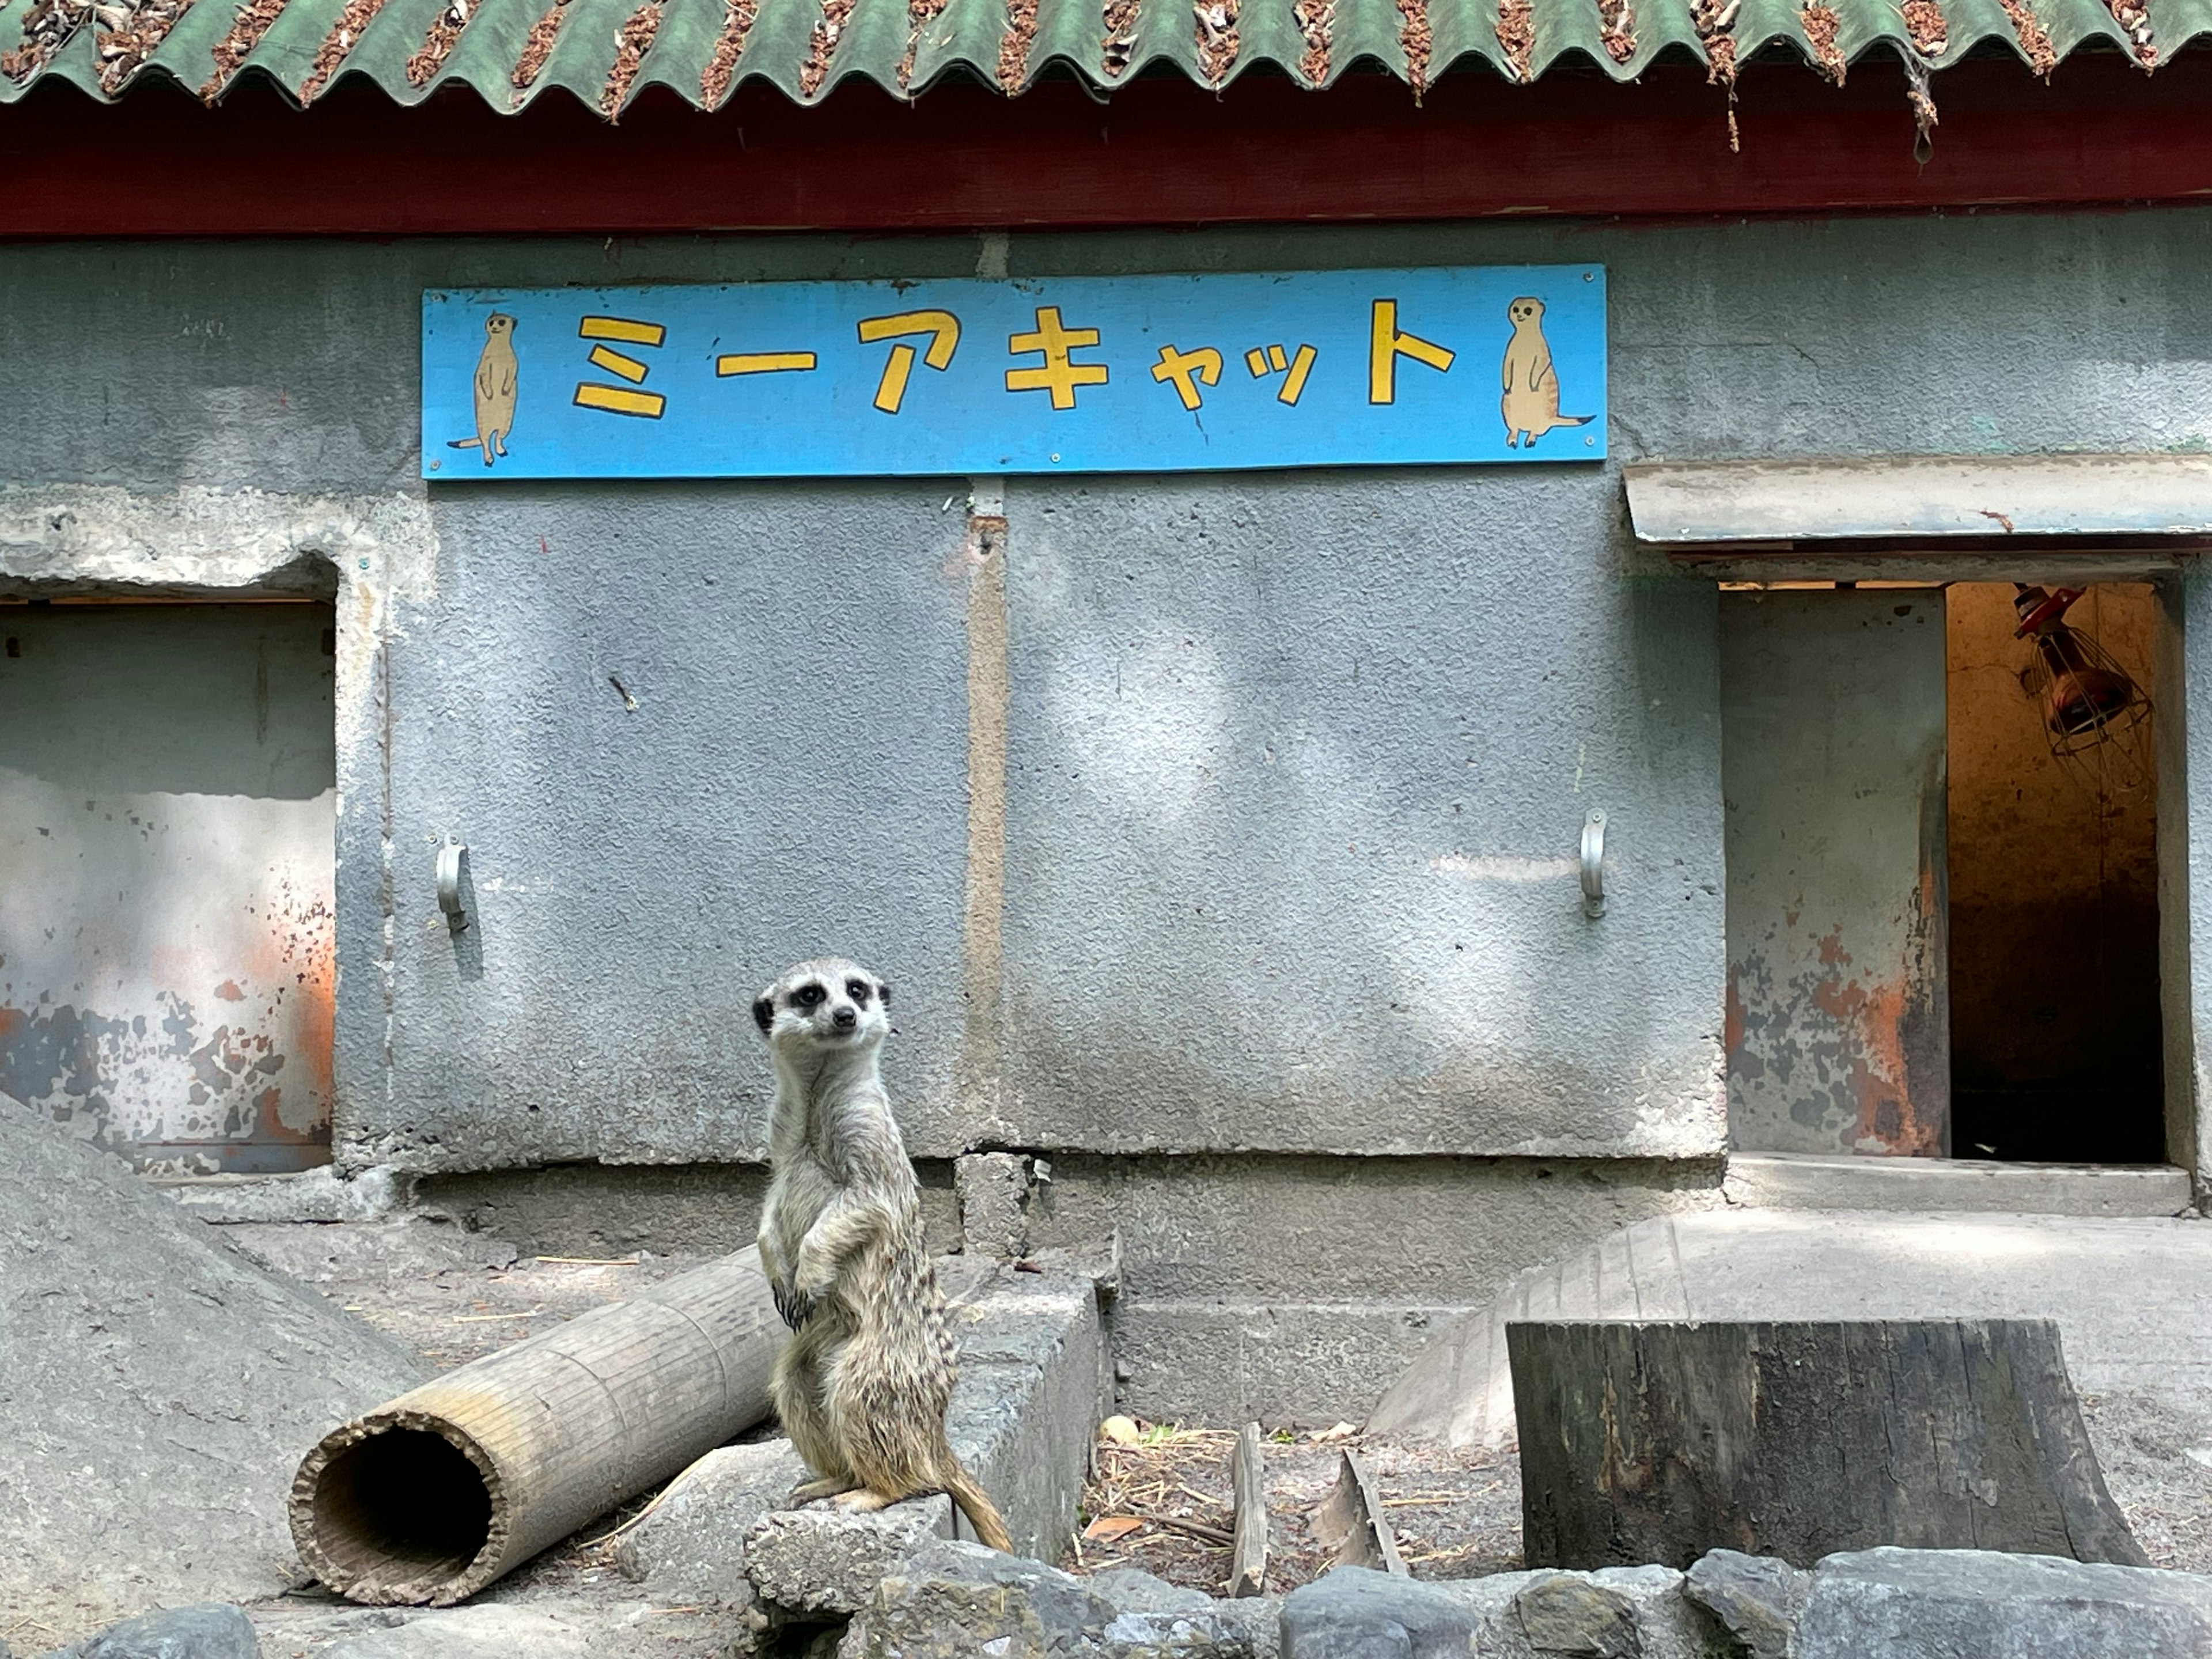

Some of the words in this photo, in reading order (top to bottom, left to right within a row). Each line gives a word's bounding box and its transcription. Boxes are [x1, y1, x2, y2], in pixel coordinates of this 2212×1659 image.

[574, 300, 1455, 419] ミーアキャット
